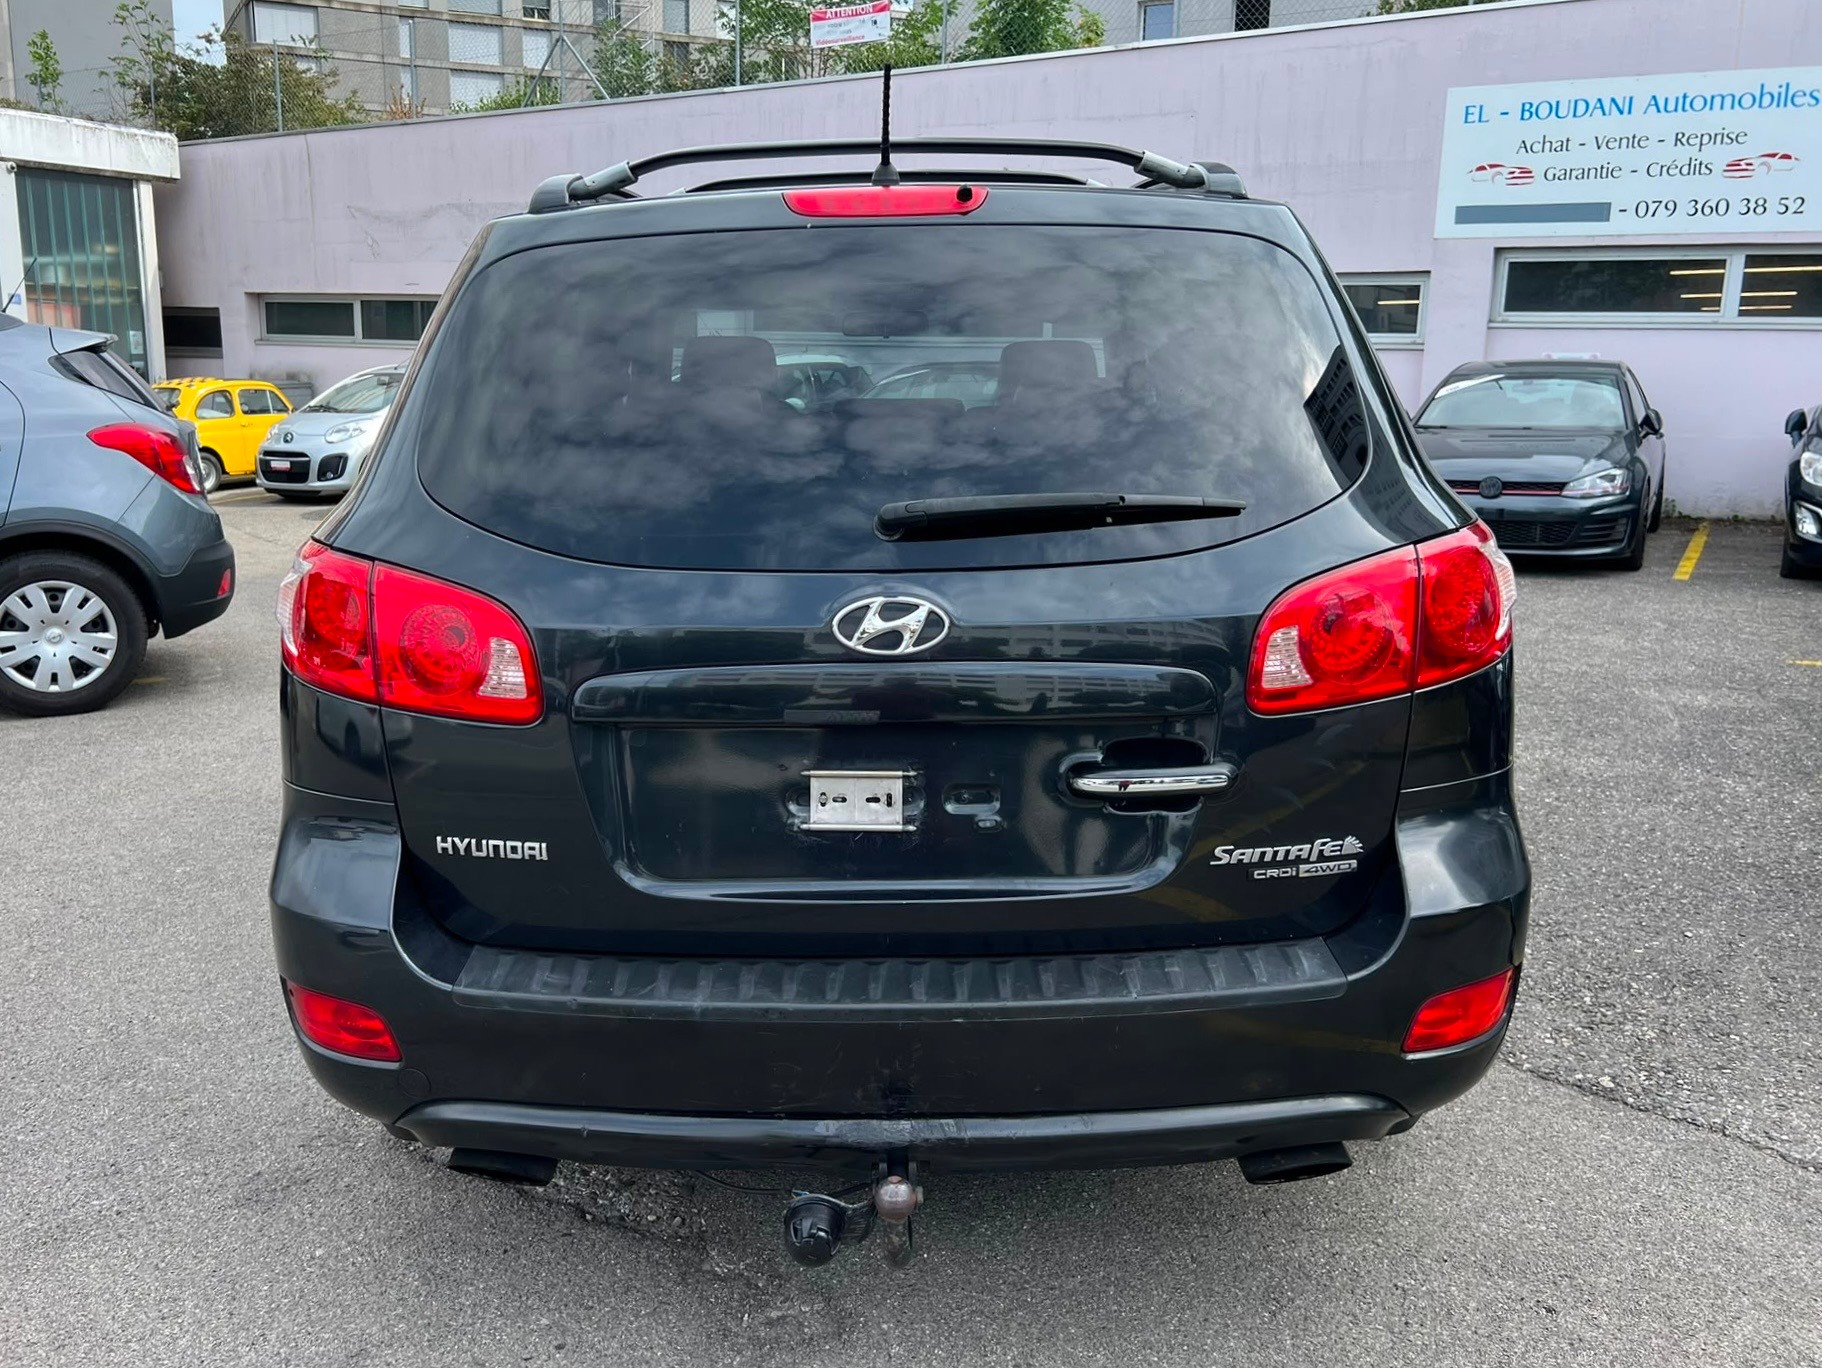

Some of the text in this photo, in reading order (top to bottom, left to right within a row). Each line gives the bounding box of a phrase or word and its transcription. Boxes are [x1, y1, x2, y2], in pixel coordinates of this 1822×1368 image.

[826, 5, 873, 19] ATTENTION
[1463, 104, 1490, 124] EL
[1519, 96, 1635, 121] BOUDANI
[1643, 82, 1821, 115] Automobiles
[1516, 134, 1572, 154] Achat
[1594, 133, 1649, 151] Vente
[1673, 127, 1748, 152] Reprise
[1543, 162, 1622, 182] Garantie
[1646, 157, 1713, 178] Crédits
[1635, 199, 1677, 218] 079
[1686, 198, 1730, 217] 360
[1738, 197, 1767, 216] 38
[1777, 196, 1806, 215] 52
[436, 835, 548, 860] HYUNDAI
[1253, 862, 1352, 879] CRDi 4WD
